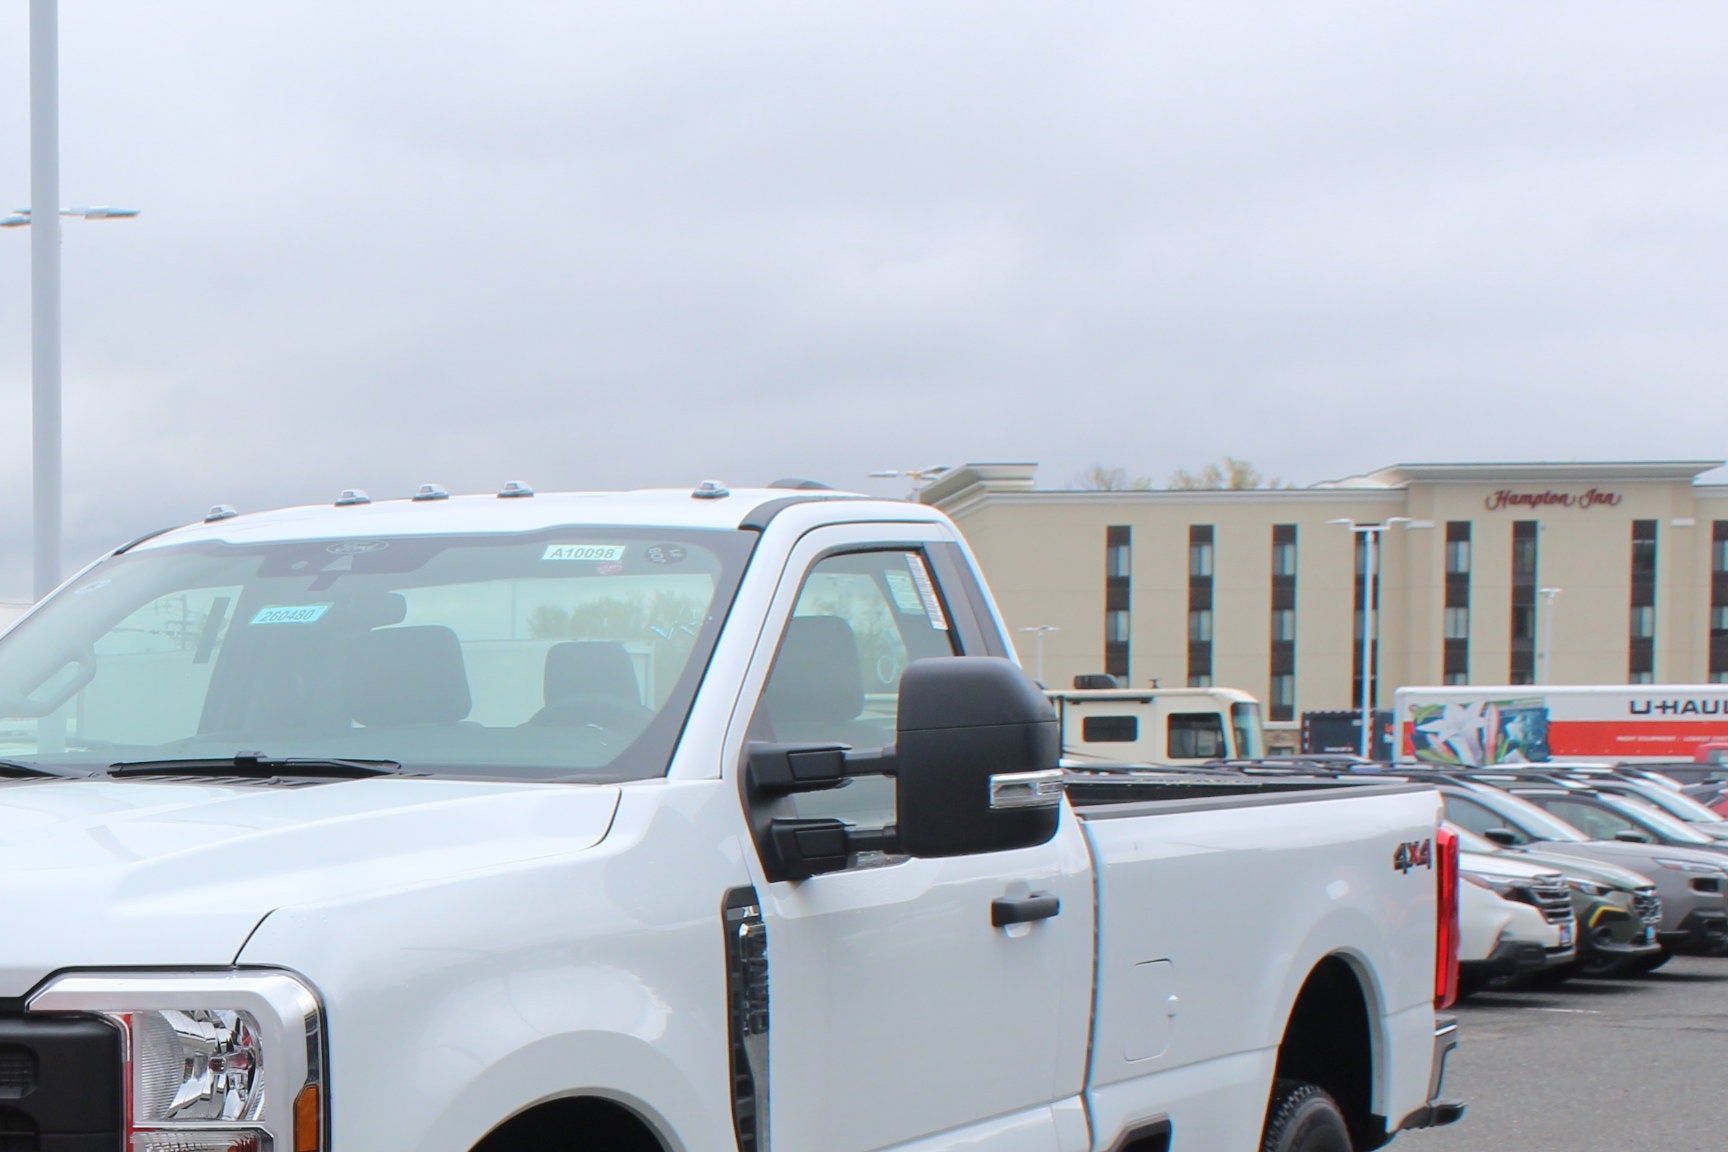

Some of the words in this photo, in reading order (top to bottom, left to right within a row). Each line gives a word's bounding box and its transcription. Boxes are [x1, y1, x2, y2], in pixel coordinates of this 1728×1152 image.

[1484, 489, 1576, 511] Hampton
[1578, 488, 1622, 510] Inn
[550, 546, 615, 560] A10098
[1629, 699, 1728, 715] U-HAU
